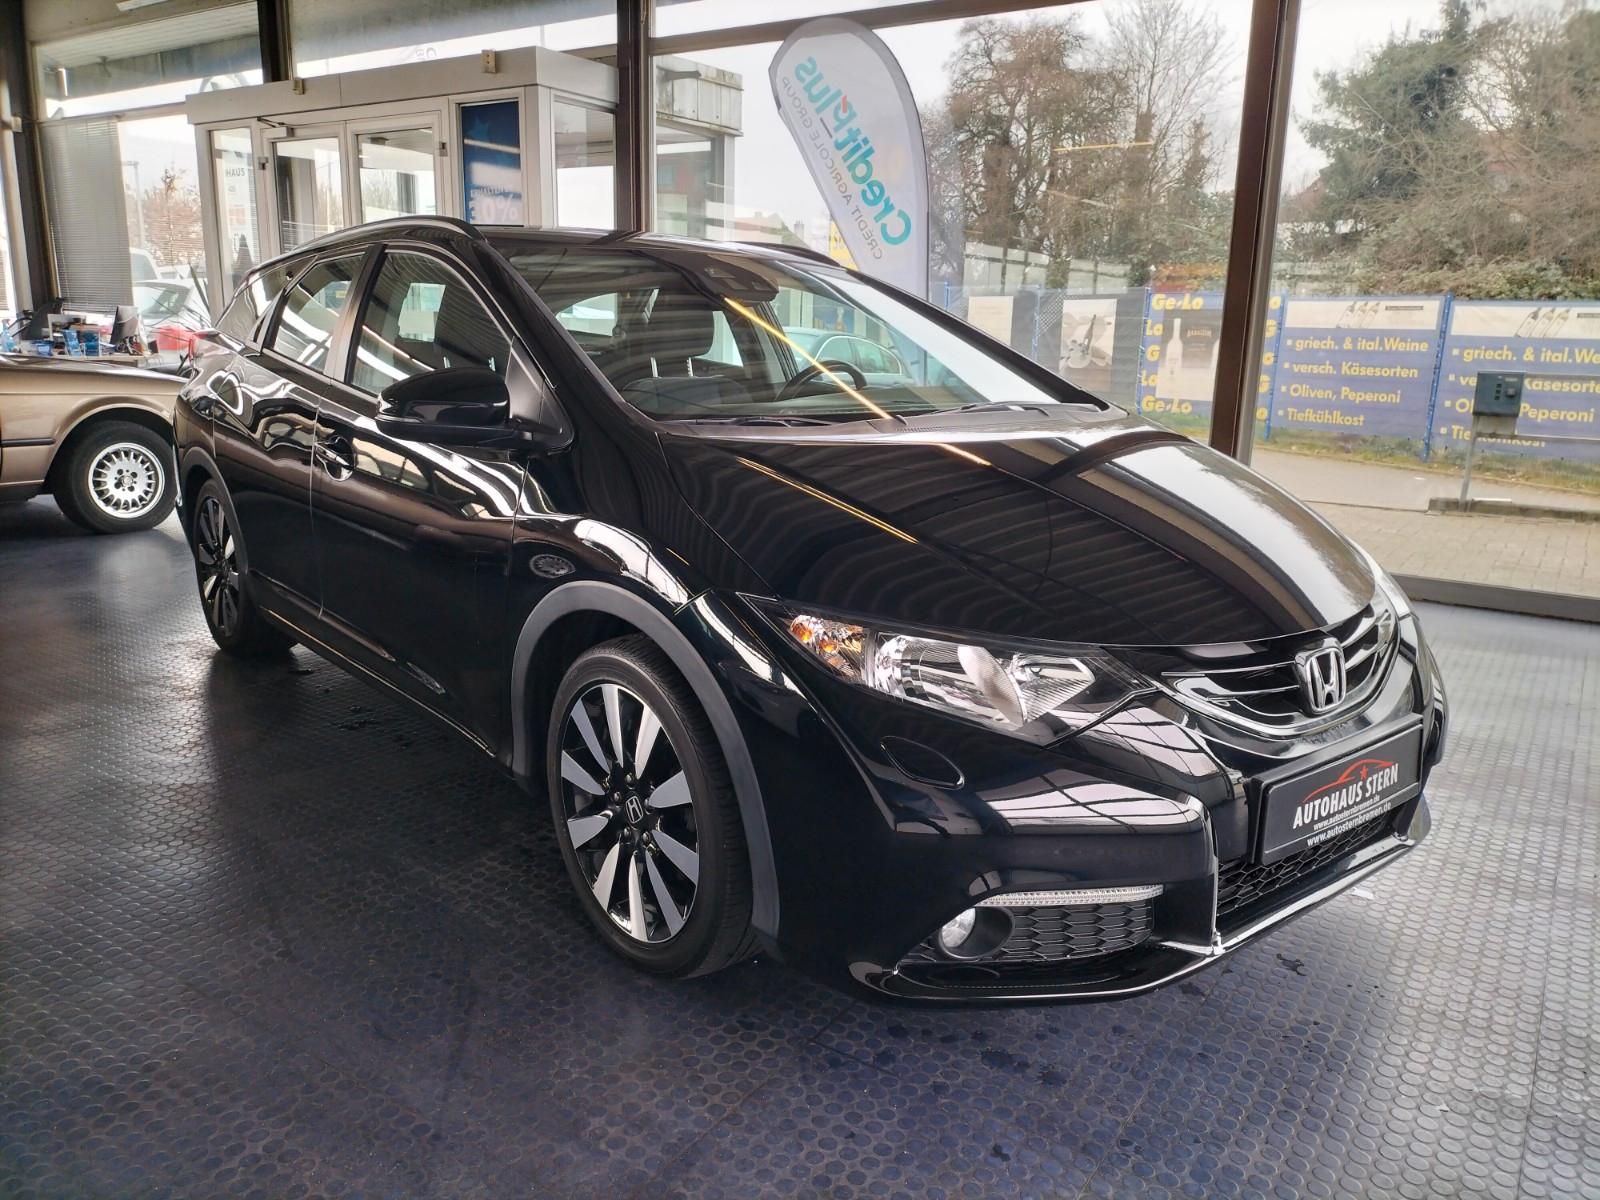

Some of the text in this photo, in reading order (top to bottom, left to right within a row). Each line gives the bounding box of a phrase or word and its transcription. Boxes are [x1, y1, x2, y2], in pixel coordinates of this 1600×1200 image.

[1295, 335, 1339, 352] griech.
[1343, 336, 1353, 351] &
[1463, 345, 1517, 362] griech.
[1523, 346, 1535, 362] &
[1292, 360, 1419, 378] versch. Käsesorten
[1289, 383, 1401, 404] Oliven, Peperoni
[1287, 407, 1365, 426] Tiefkühlkost
[1519, 403, 1595, 423] Peperoni
[1292, 763, 1399, 829] AUTOHAUS STERN
[1307, 801, 1392, 847] www.autosternbremen.de
